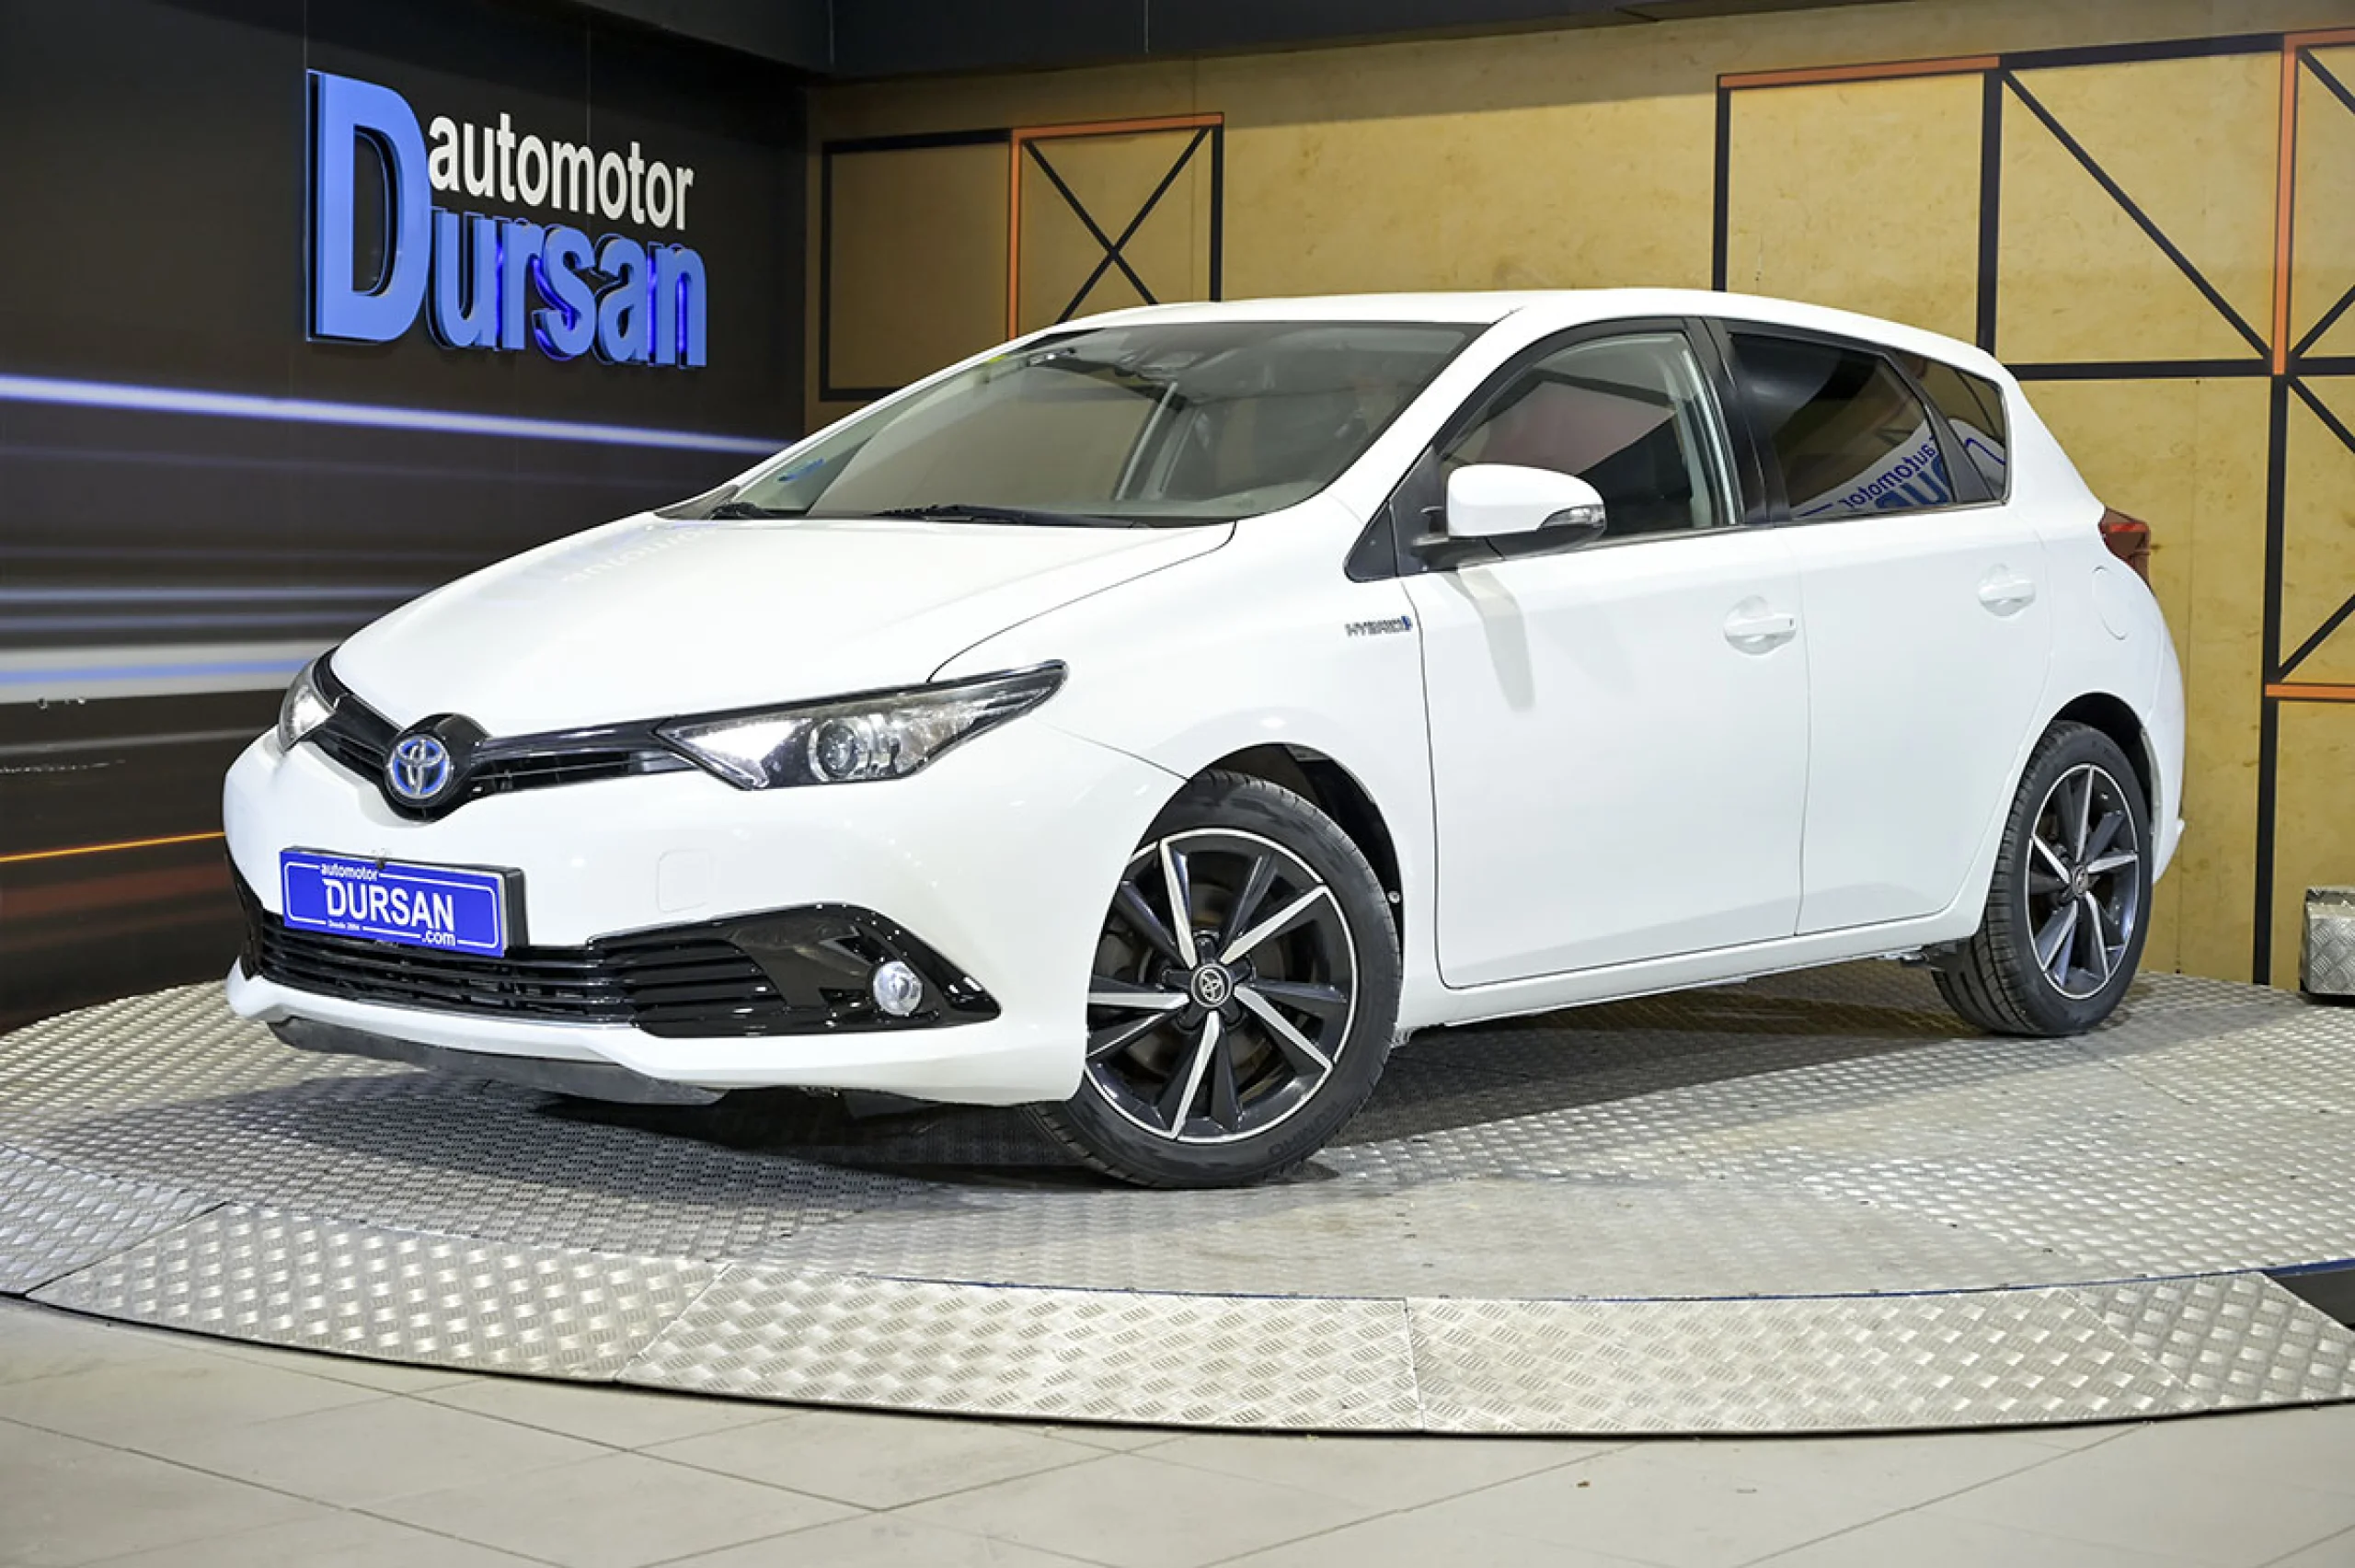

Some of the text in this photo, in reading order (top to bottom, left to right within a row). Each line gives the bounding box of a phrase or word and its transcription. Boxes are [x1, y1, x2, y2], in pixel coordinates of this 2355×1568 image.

[429, 112, 694, 231] automotor
[306, 68, 707, 369] Dursan
[321, 864, 378, 881] automotor
[322, 878, 454, 932] DURSAN
[421, 930, 456, 947] .com
